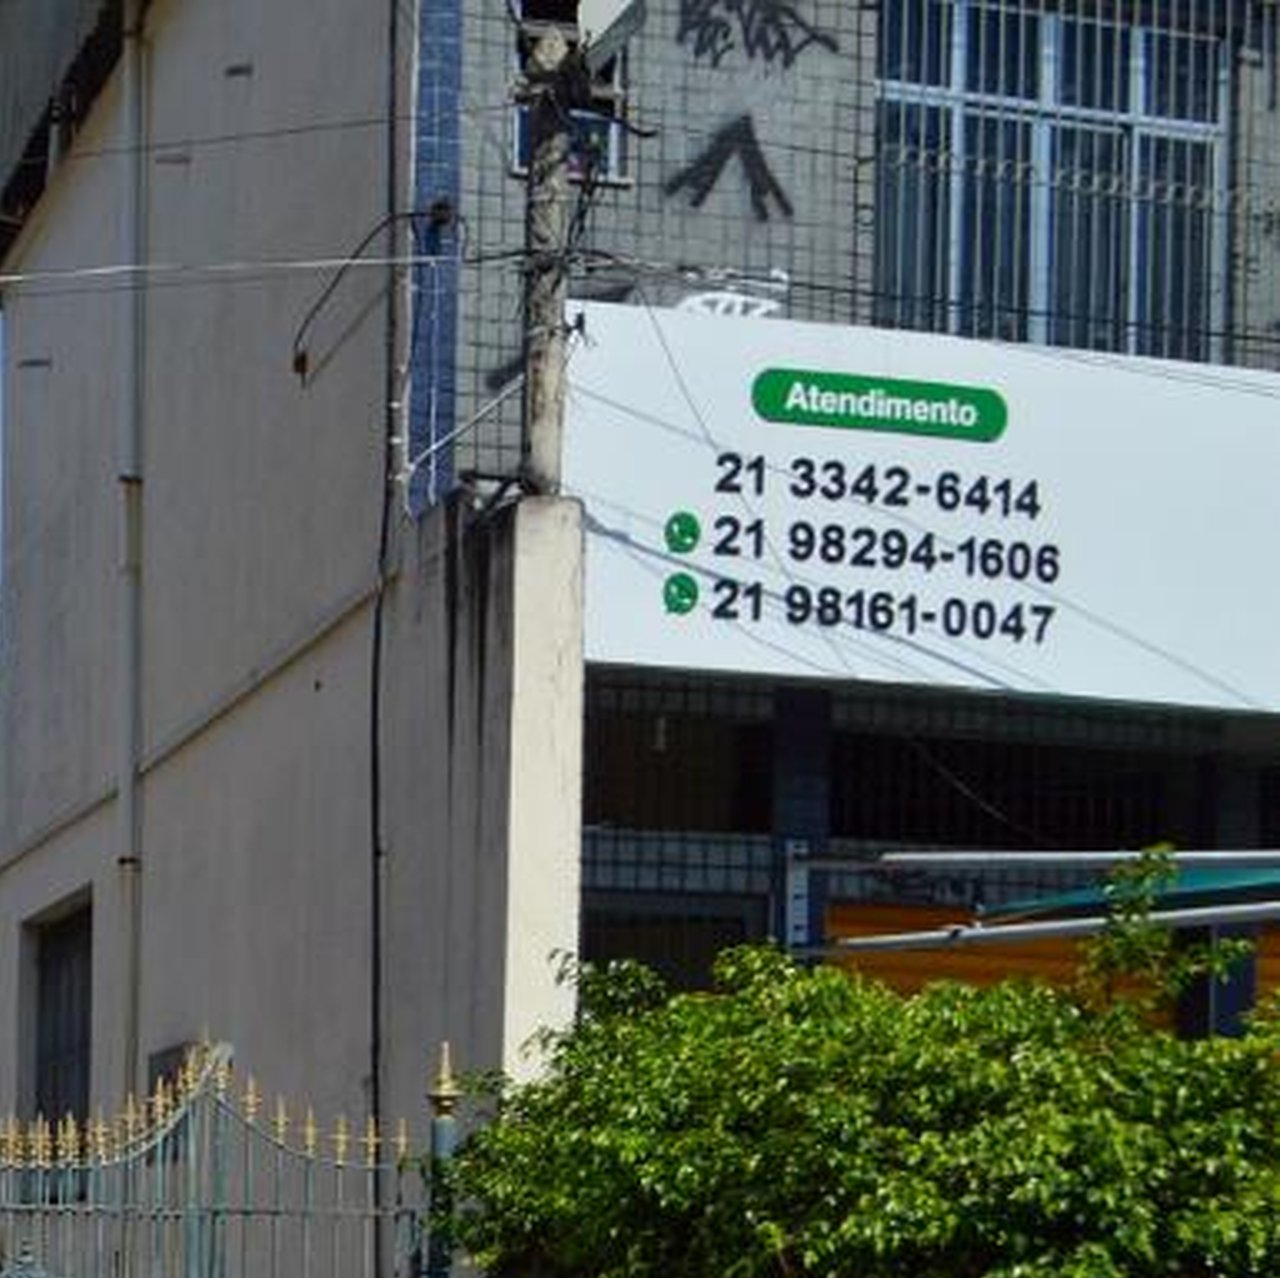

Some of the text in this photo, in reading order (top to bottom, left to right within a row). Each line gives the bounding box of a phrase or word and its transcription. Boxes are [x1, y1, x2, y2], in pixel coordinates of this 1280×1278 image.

[786, 381, 979, 428] Atendimento
[714, 452, 1042, 520] 21 3342-6414
[712, 516, 1061, 583] 21 98294-1606
[711, 579, 1057, 645] 21 98161-0047
